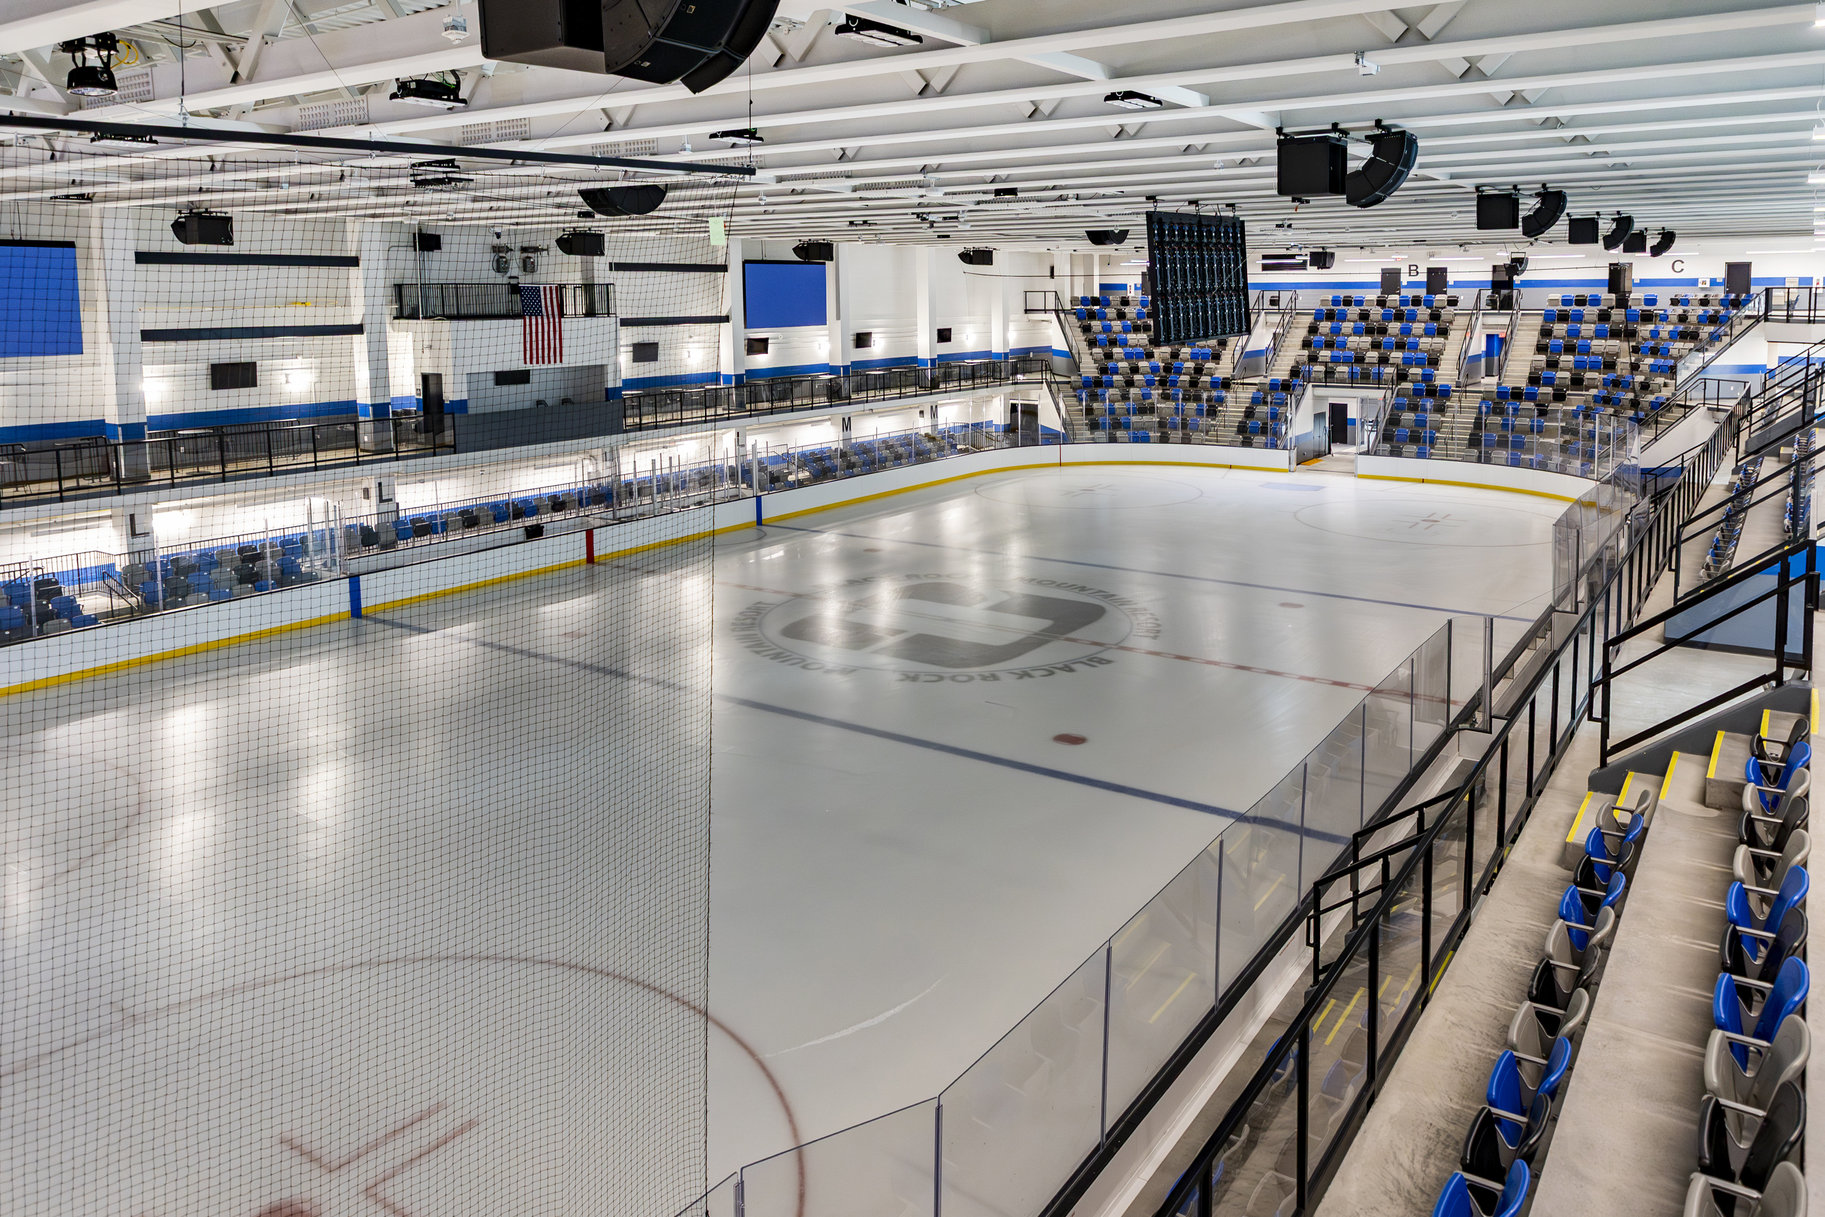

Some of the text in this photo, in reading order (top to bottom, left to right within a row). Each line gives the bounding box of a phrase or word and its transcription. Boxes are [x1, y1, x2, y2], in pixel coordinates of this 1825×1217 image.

[1408, 264, 1420, 277] B
[1671, 259, 1685, 274] C
[929, 404, 939, 420] M
[841, 416, 852, 433] M
[377, 481, 393, 504] L
[129, 512, 150, 538] L
[1006, 656, 1114, 680] BLACK
[897, 673, 1002, 683] ROCK
